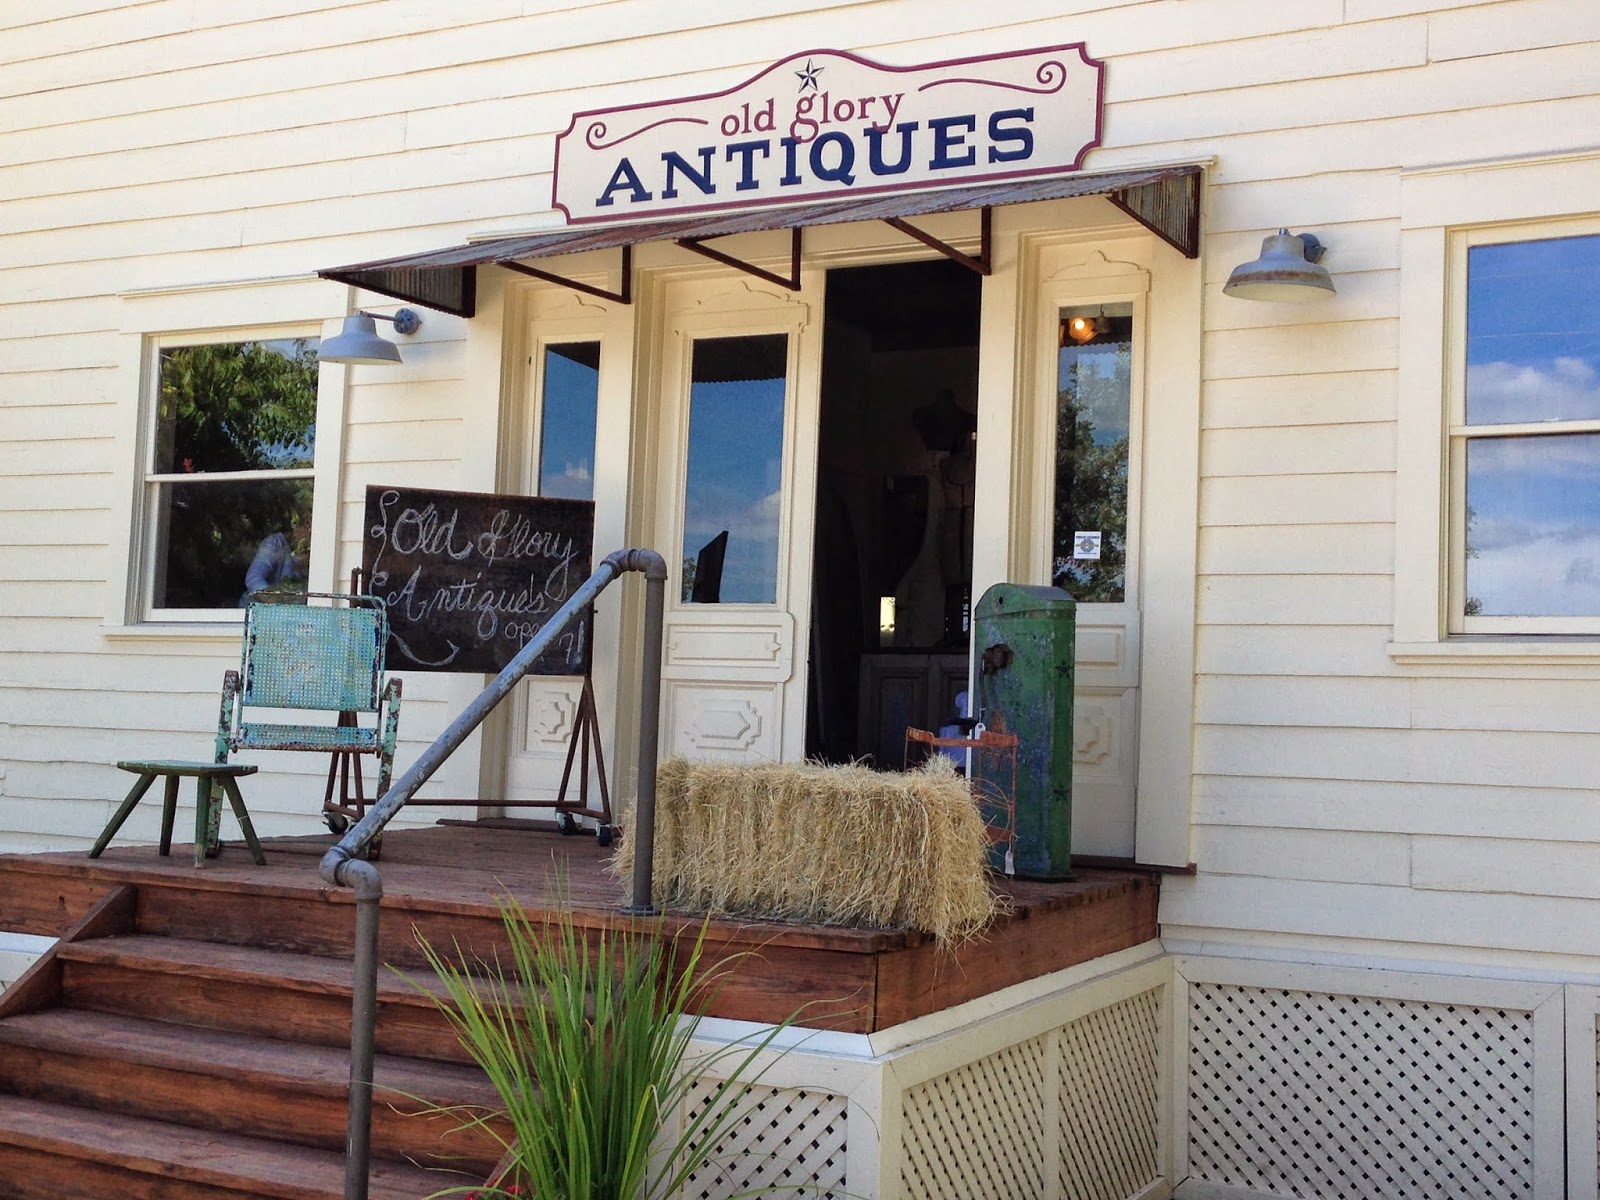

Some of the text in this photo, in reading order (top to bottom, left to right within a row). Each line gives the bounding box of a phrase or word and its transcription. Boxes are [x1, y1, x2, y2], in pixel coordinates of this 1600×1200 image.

[595, 106, 1035, 207] ANTIQUES
[720, 91, 905, 144] old glory
[391, 502, 579, 601] Old Glory
